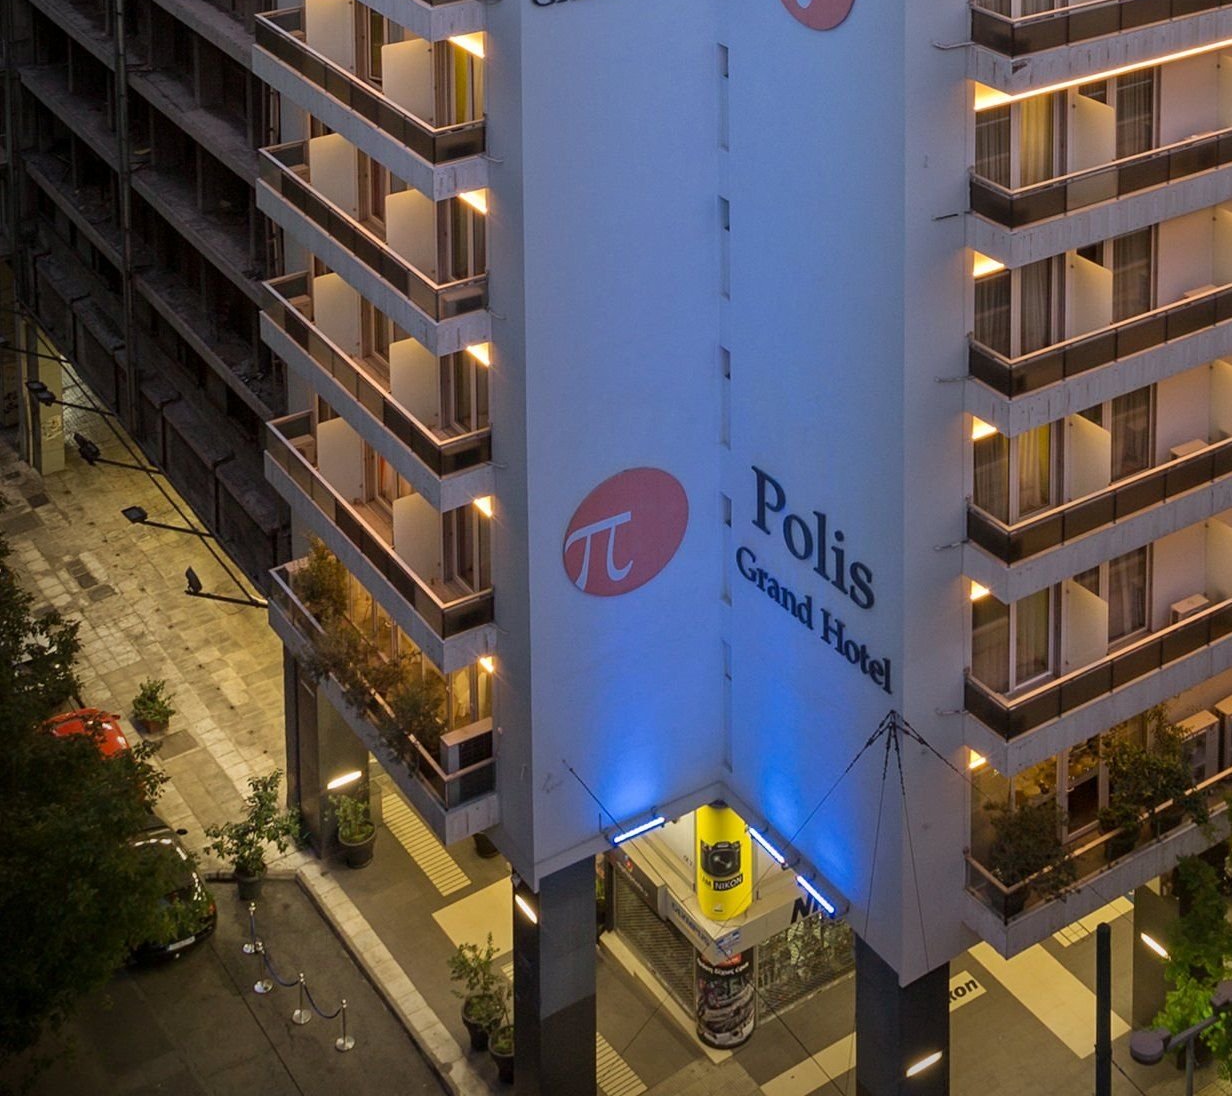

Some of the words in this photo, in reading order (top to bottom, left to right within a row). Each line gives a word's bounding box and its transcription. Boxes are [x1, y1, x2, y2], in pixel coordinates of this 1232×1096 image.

[751, 465, 875, 610] Polis
[735, 546, 814, 631] Grand
[820, 607, 892, 694] Hotel
[714, 875, 743, 890] NIKON
